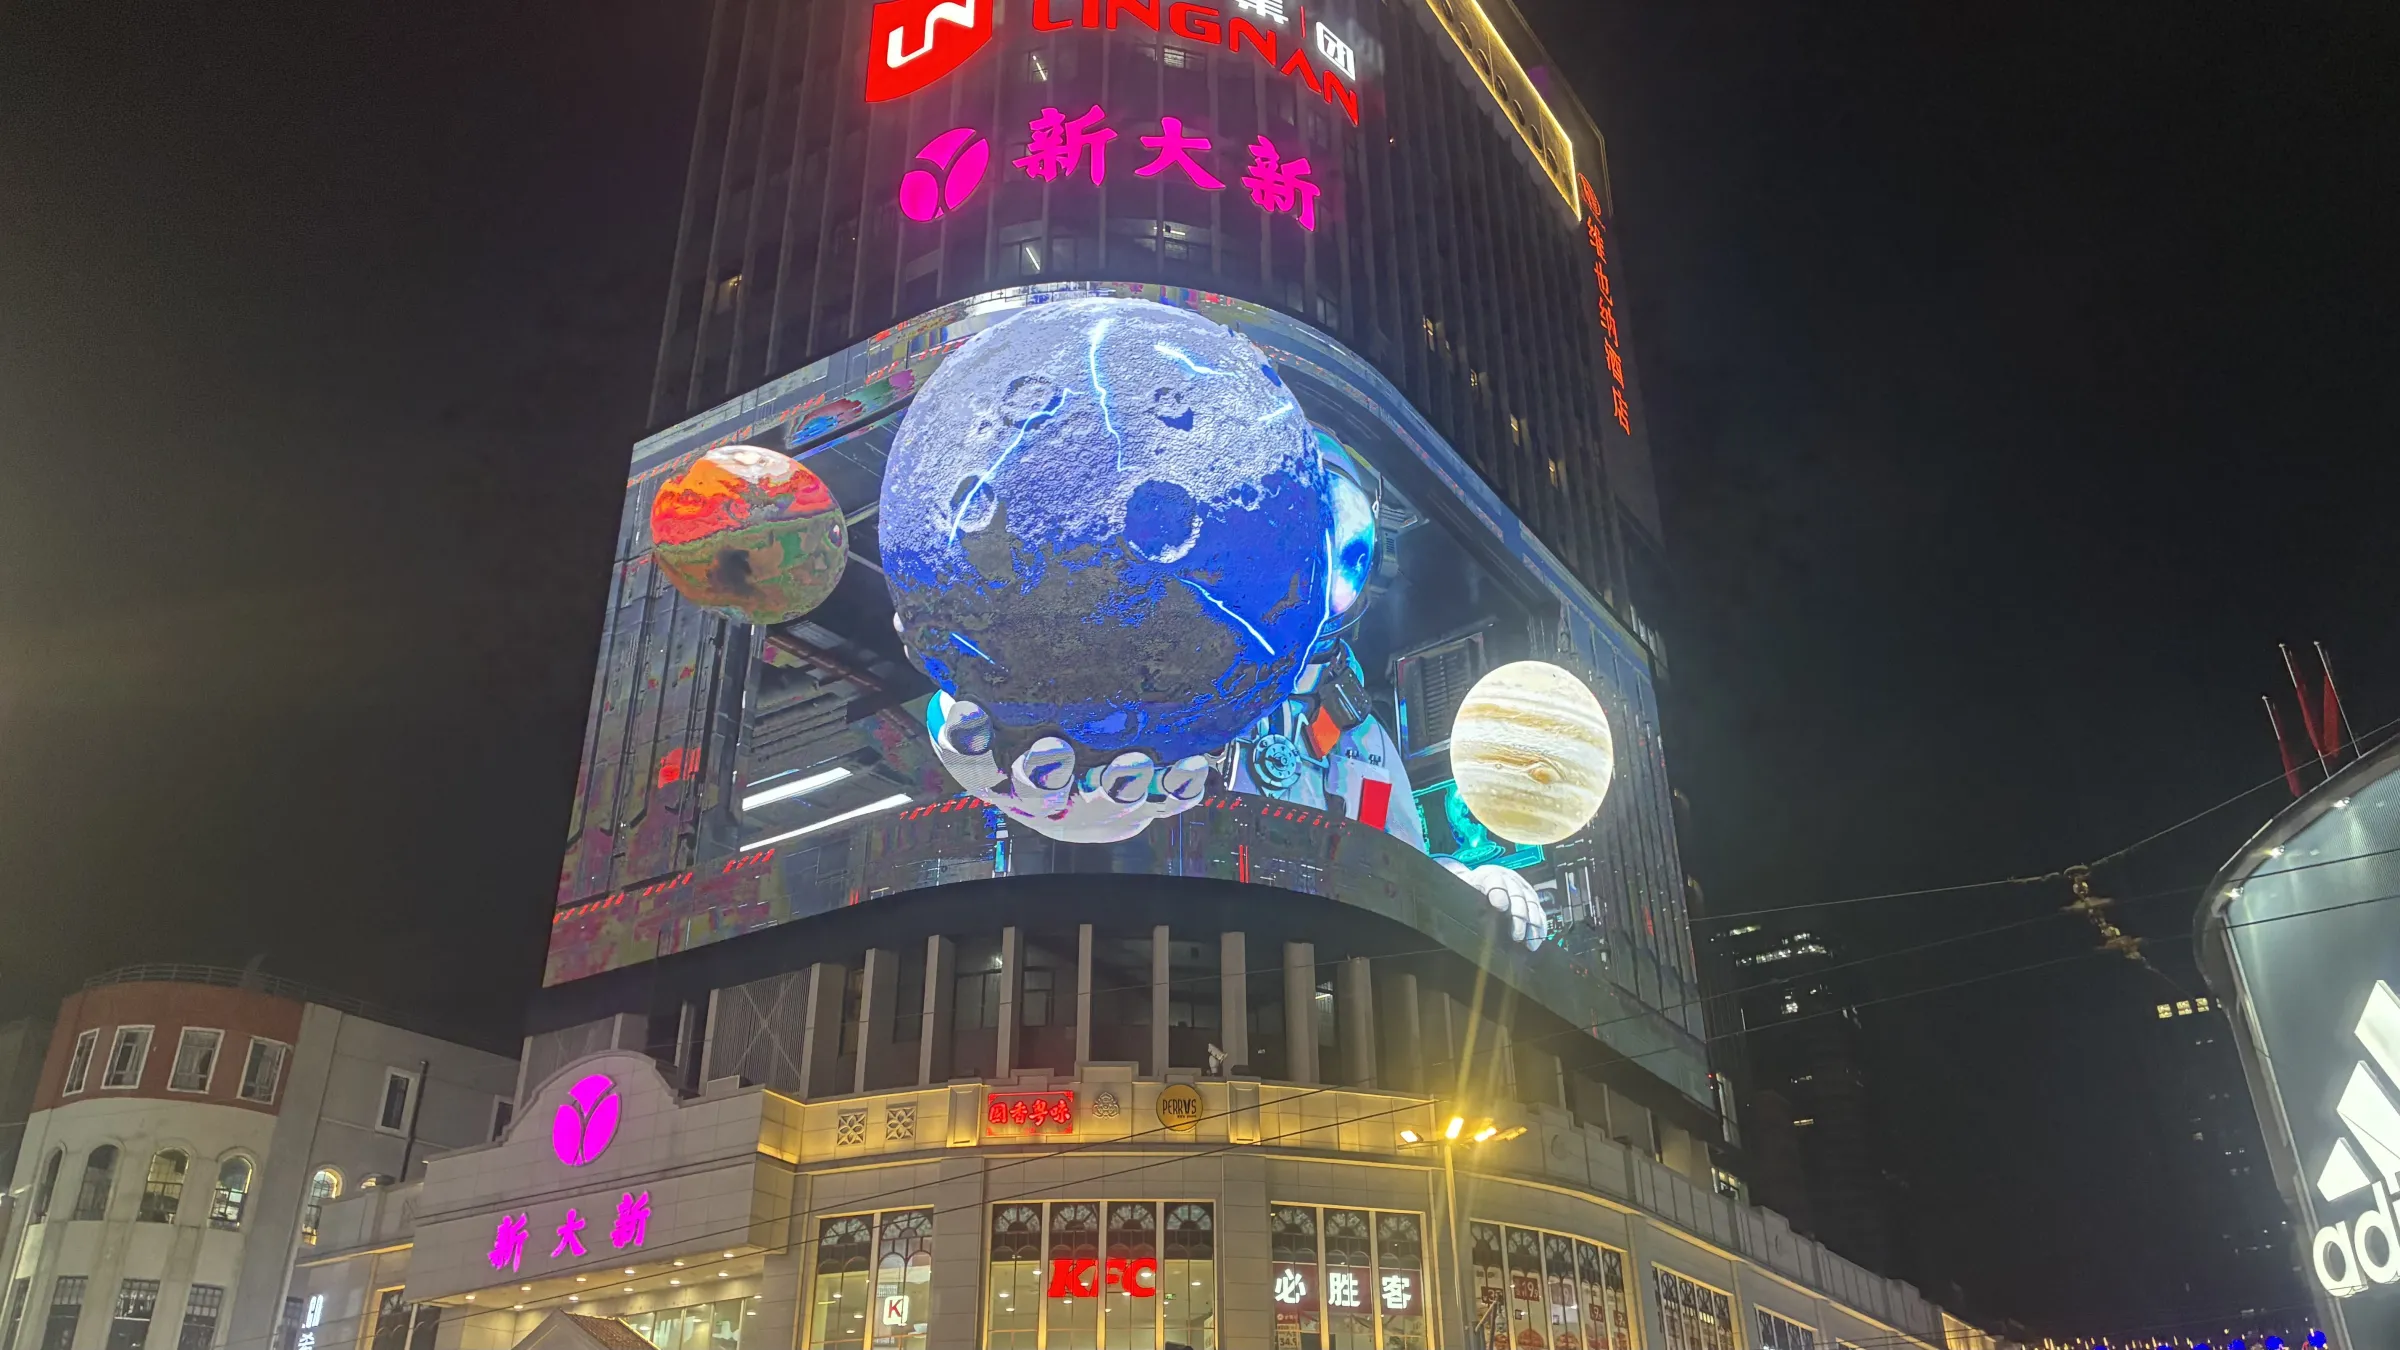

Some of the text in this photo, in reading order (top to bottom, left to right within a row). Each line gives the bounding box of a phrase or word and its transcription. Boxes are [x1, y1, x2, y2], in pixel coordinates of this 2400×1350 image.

[1012, 104, 1321, 232] 新大新
[487, 1190, 651, 1273] 新大新
[2313, 1180, 2400, 1298] ad
[1047, 1257, 1158, 1298] KFC
[1274, 1268, 1412, 1309] 必胜客
